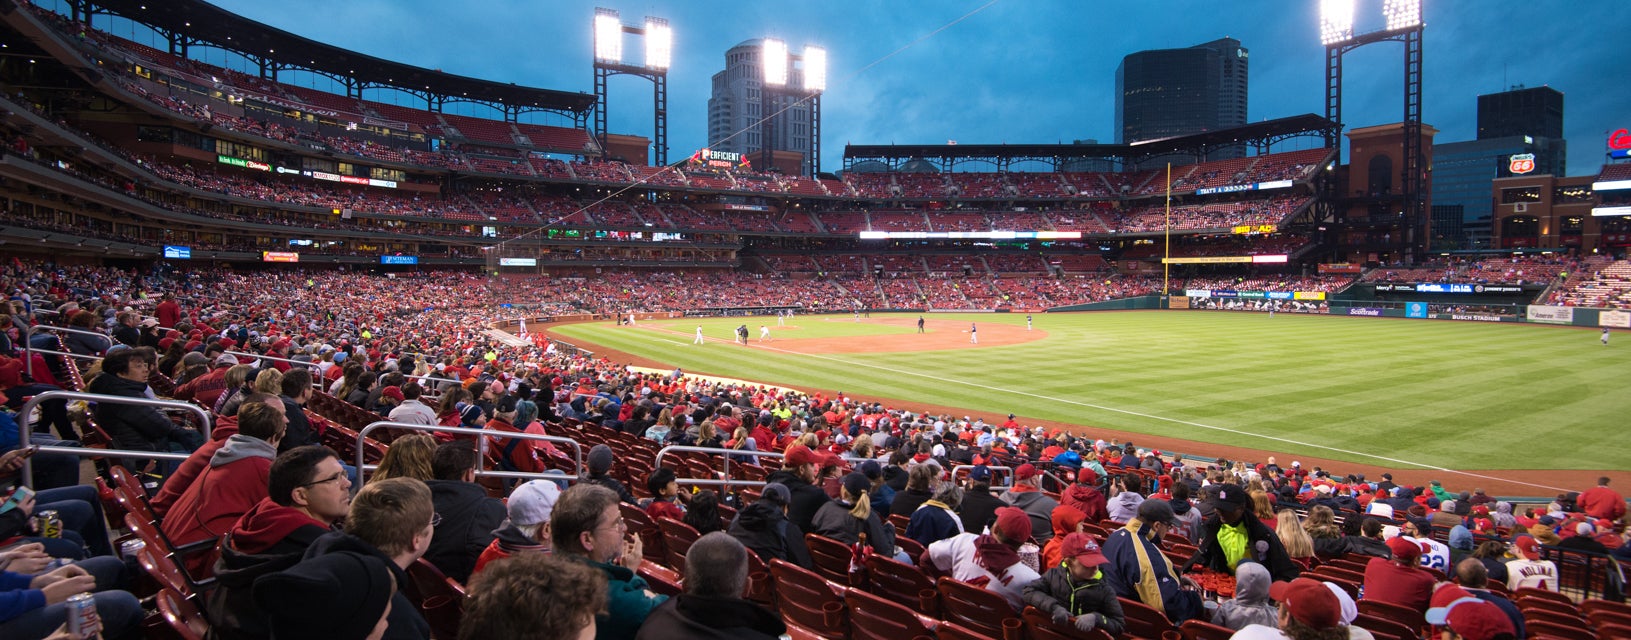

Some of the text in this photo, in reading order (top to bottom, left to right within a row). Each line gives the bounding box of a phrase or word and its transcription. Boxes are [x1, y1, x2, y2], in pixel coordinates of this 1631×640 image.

[702, 148, 739, 161] PERFICIENT
[1514, 161, 1530, 171] 66
[1235, 225, 1250, 234] BIG
[1350, 306, 1379, 316] Scottrade
[1519, 565, 1553, 578] MOLINA
